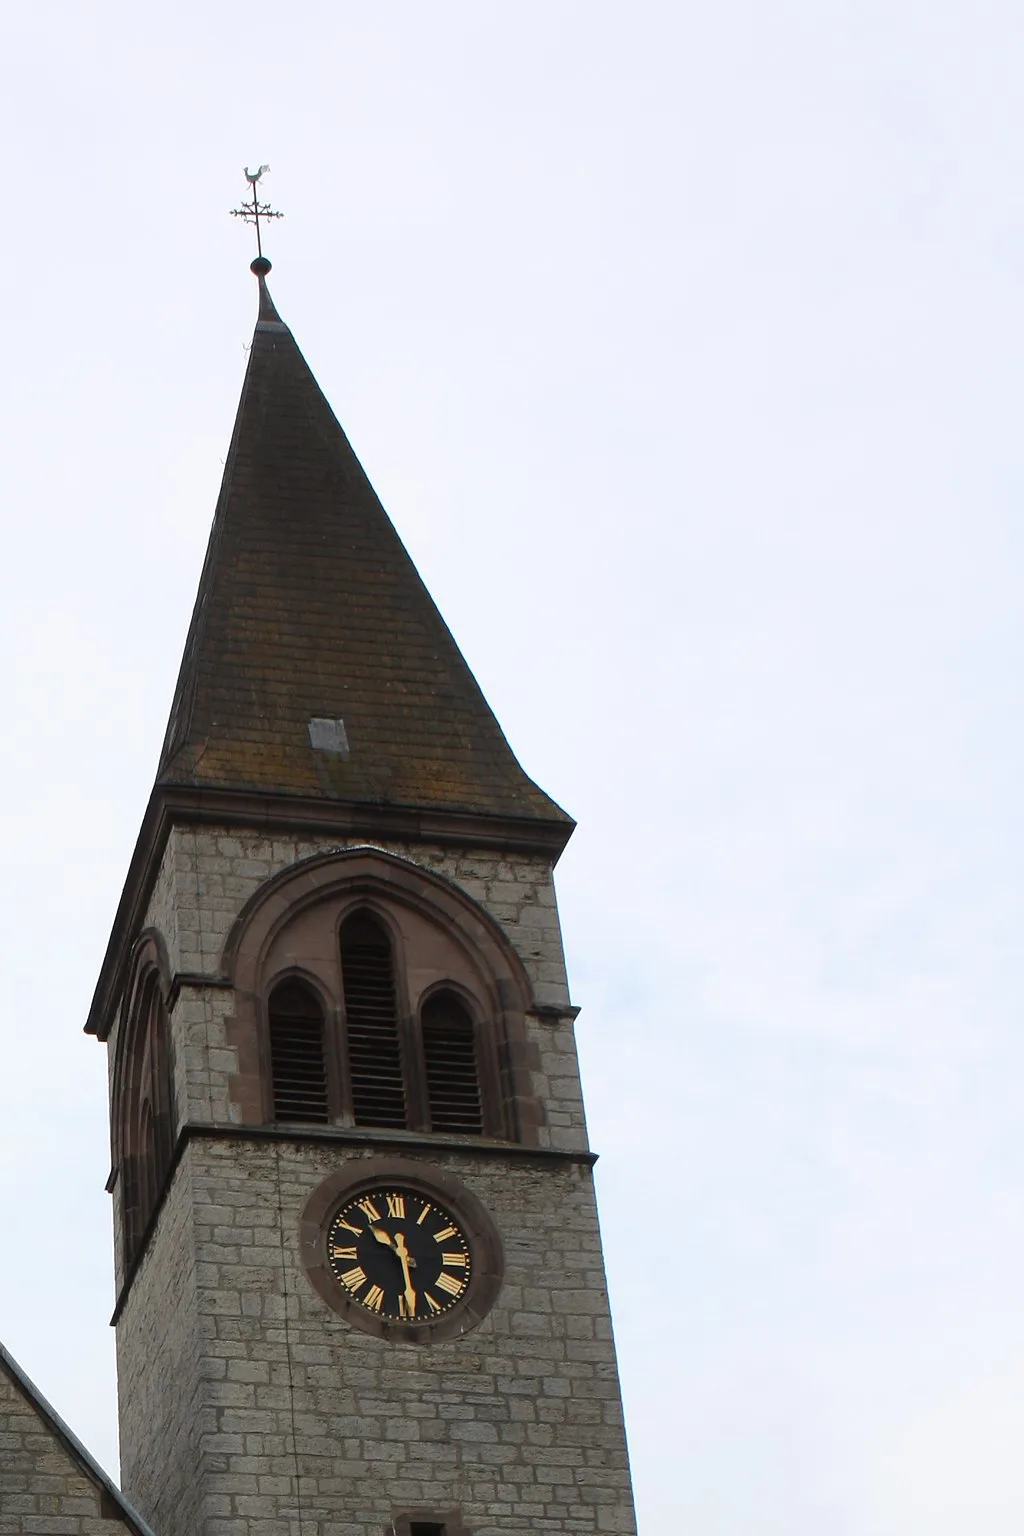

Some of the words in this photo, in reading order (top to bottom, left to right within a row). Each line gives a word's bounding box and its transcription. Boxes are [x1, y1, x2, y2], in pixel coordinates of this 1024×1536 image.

[358, 1200, 381, 1223] XI
[386, 1196, 406, 1219] XII
[338, 1219, 363, 1238] X
[432, 1226, 457, 1244] II
[442, 1252, 466, 1267] III
[340, 1266, 368, 1293] VIII
[363, 1284, 385, 1311] VII
[423, 1291, 442, 1312] V
